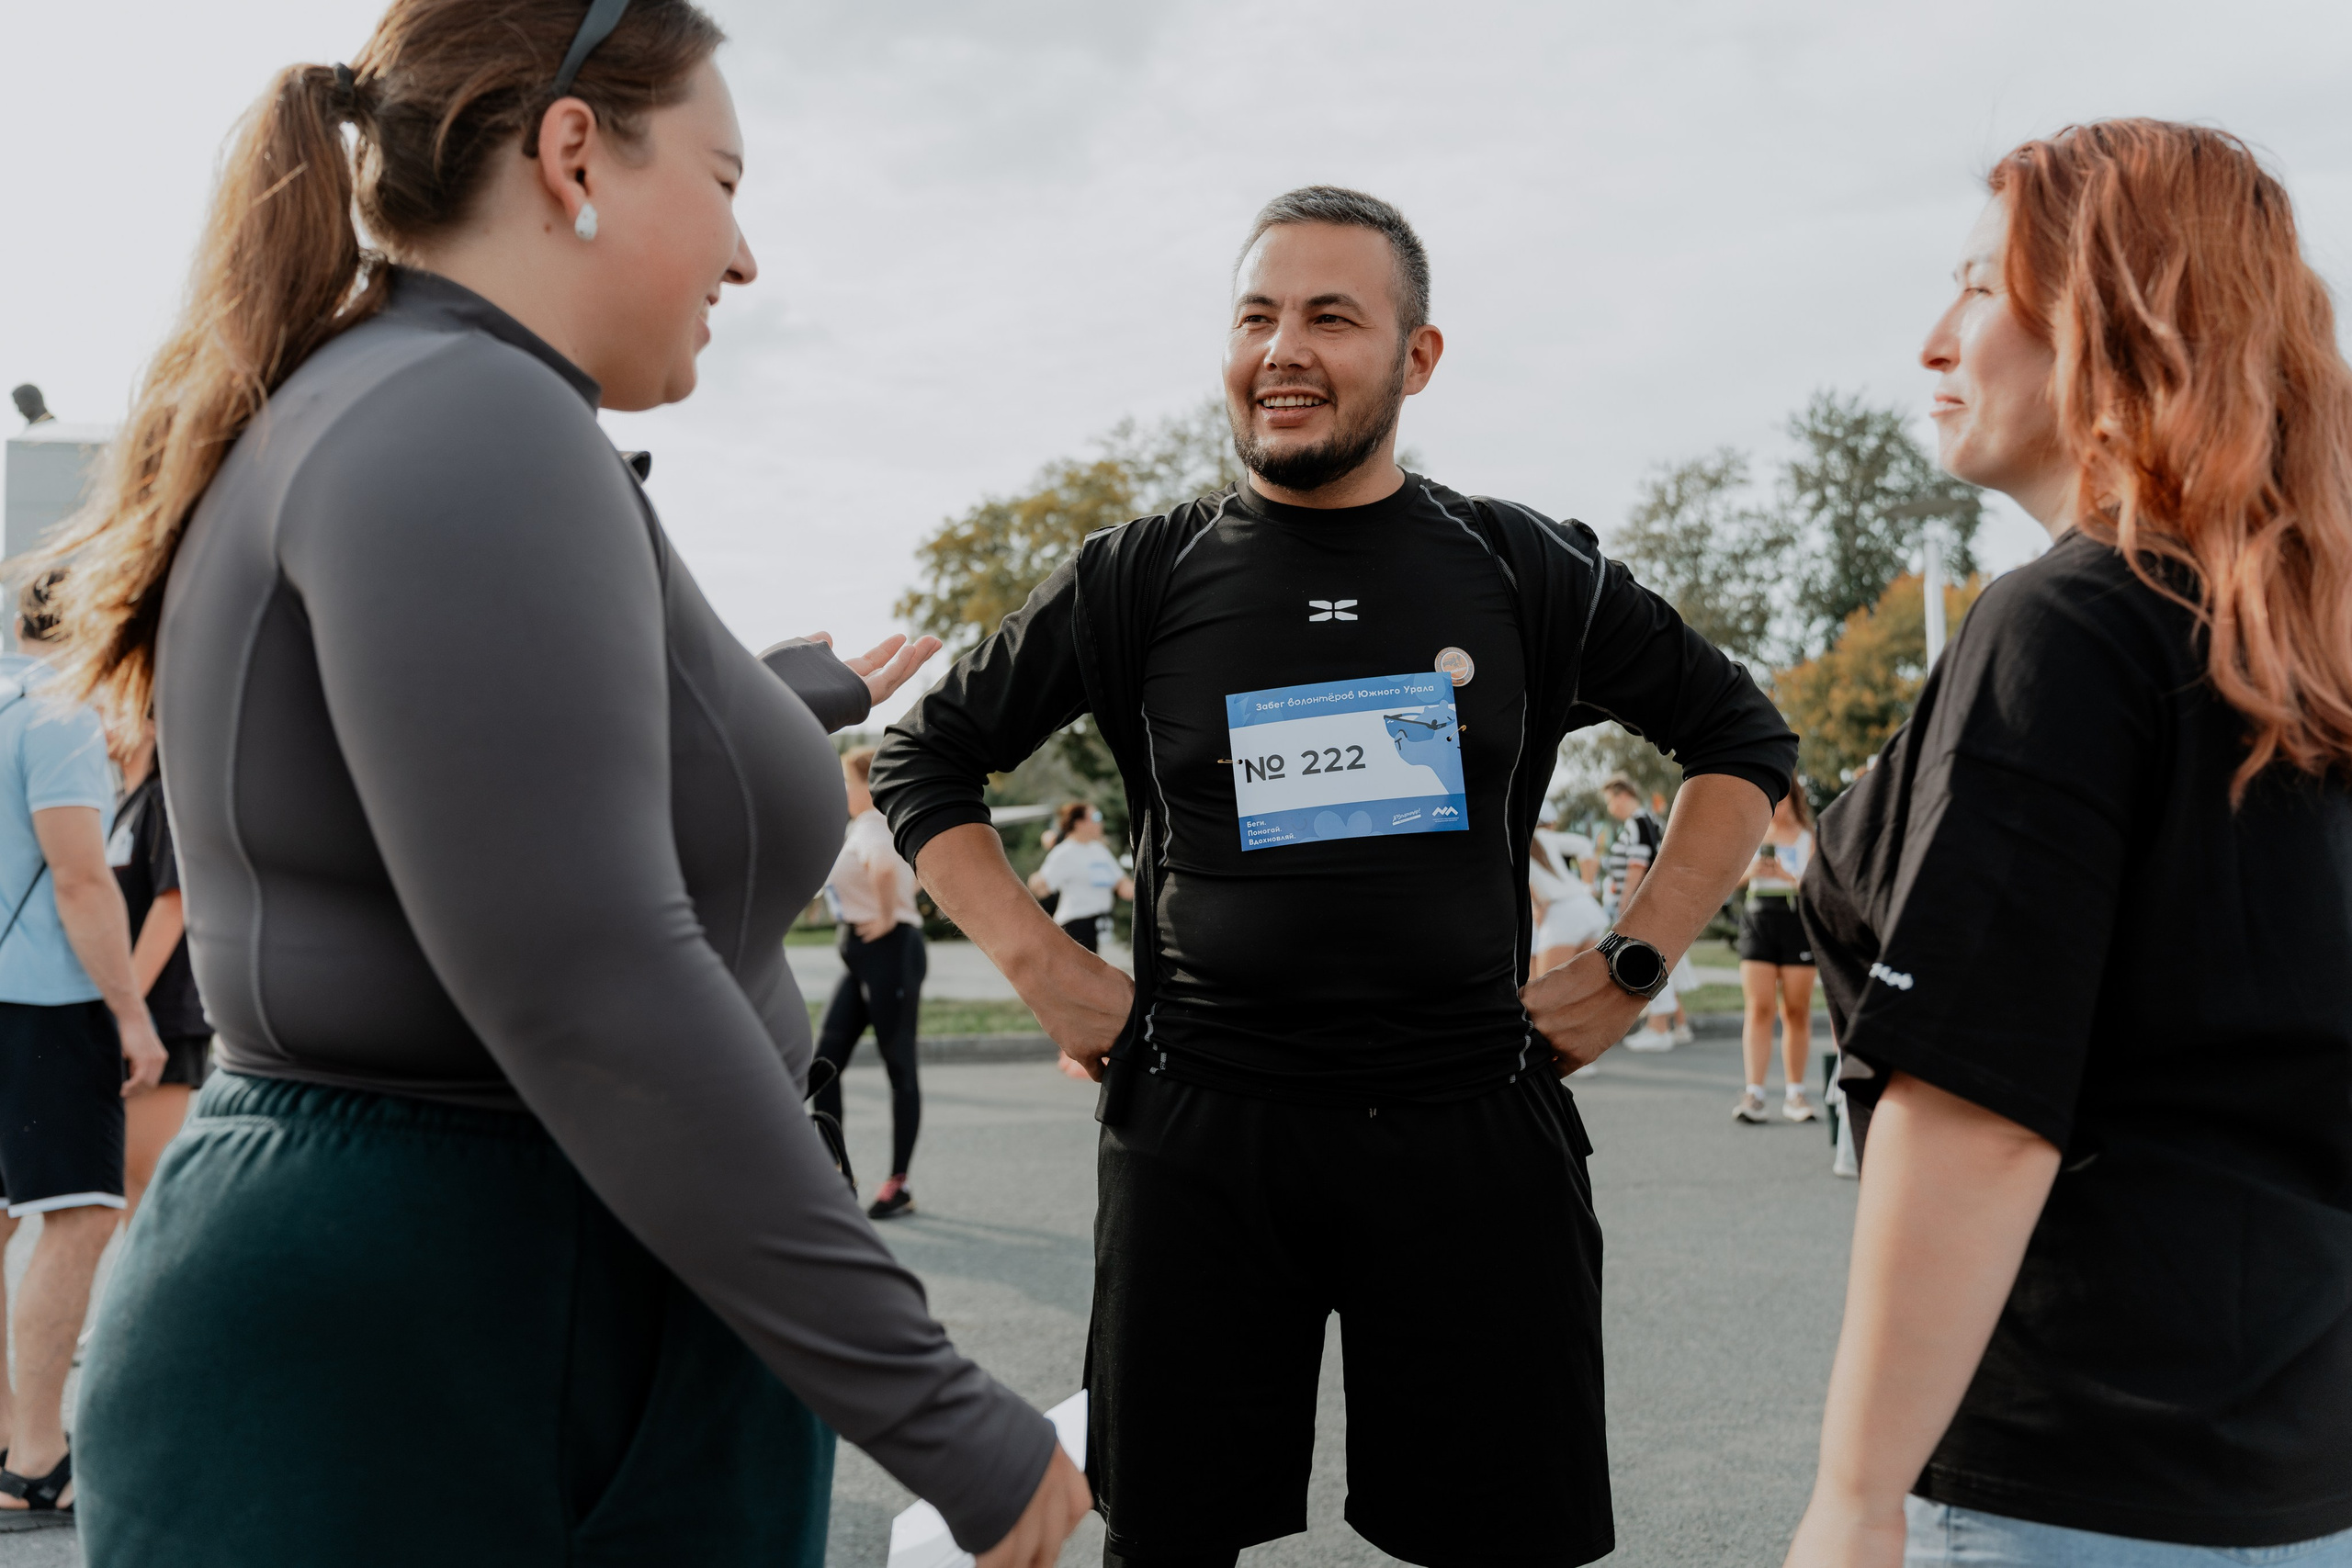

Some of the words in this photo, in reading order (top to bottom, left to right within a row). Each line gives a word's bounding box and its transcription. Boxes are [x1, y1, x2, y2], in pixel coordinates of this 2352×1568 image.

[1256, 701, 1284, 711] Забег
[1287, 691, 1354, 707] волонтёров
[1358, 689, 1400, 698] Южного
[1403, 685, 1434, 694] Урала
[1301, 745, 1366, 775] 222
[1248, 827, 1283, 837] Помогай.
[1249, 833, 1296, 846] Вдохновляй.
